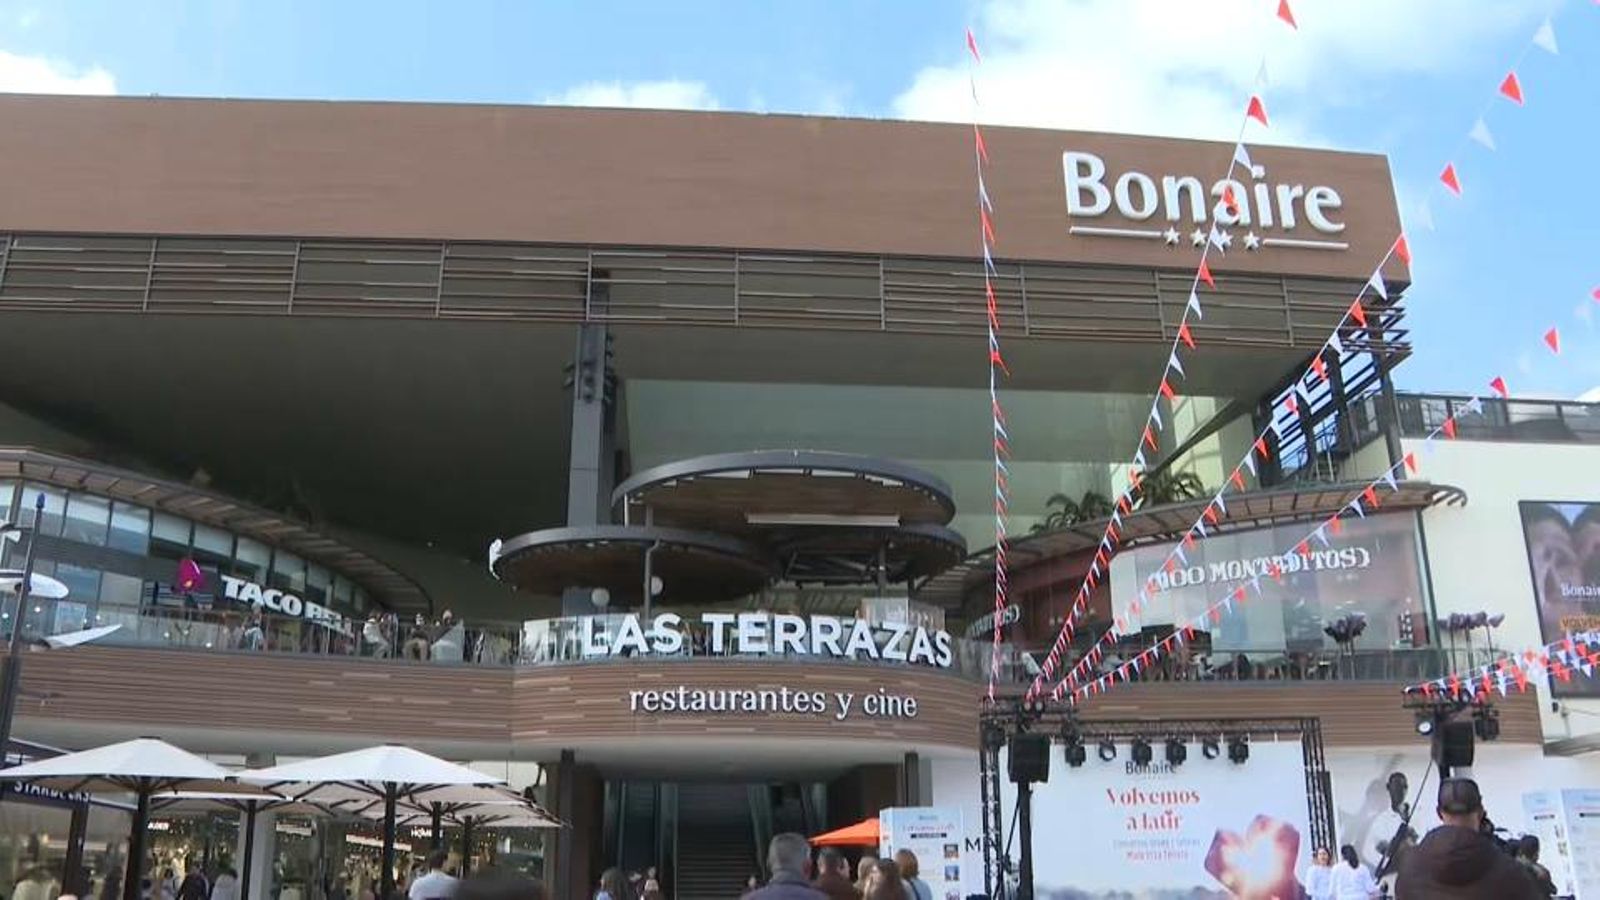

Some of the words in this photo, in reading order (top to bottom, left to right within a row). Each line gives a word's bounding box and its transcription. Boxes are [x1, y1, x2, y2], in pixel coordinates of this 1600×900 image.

[1062, 151, 1346, 233] Bonaire
[221, 574, 303, 616] TACO
[581, 612, 683, 655] LAS
[702, 612, 952, 668] TERRAZAS
[629, 686, 826, 713] restaurantes
[834, 690, 853, 720] y
[863, 687, 917, 717] cine
[1106, 787, 1201, 805] Volvemos
[1127, 816, 1137, 831] a
